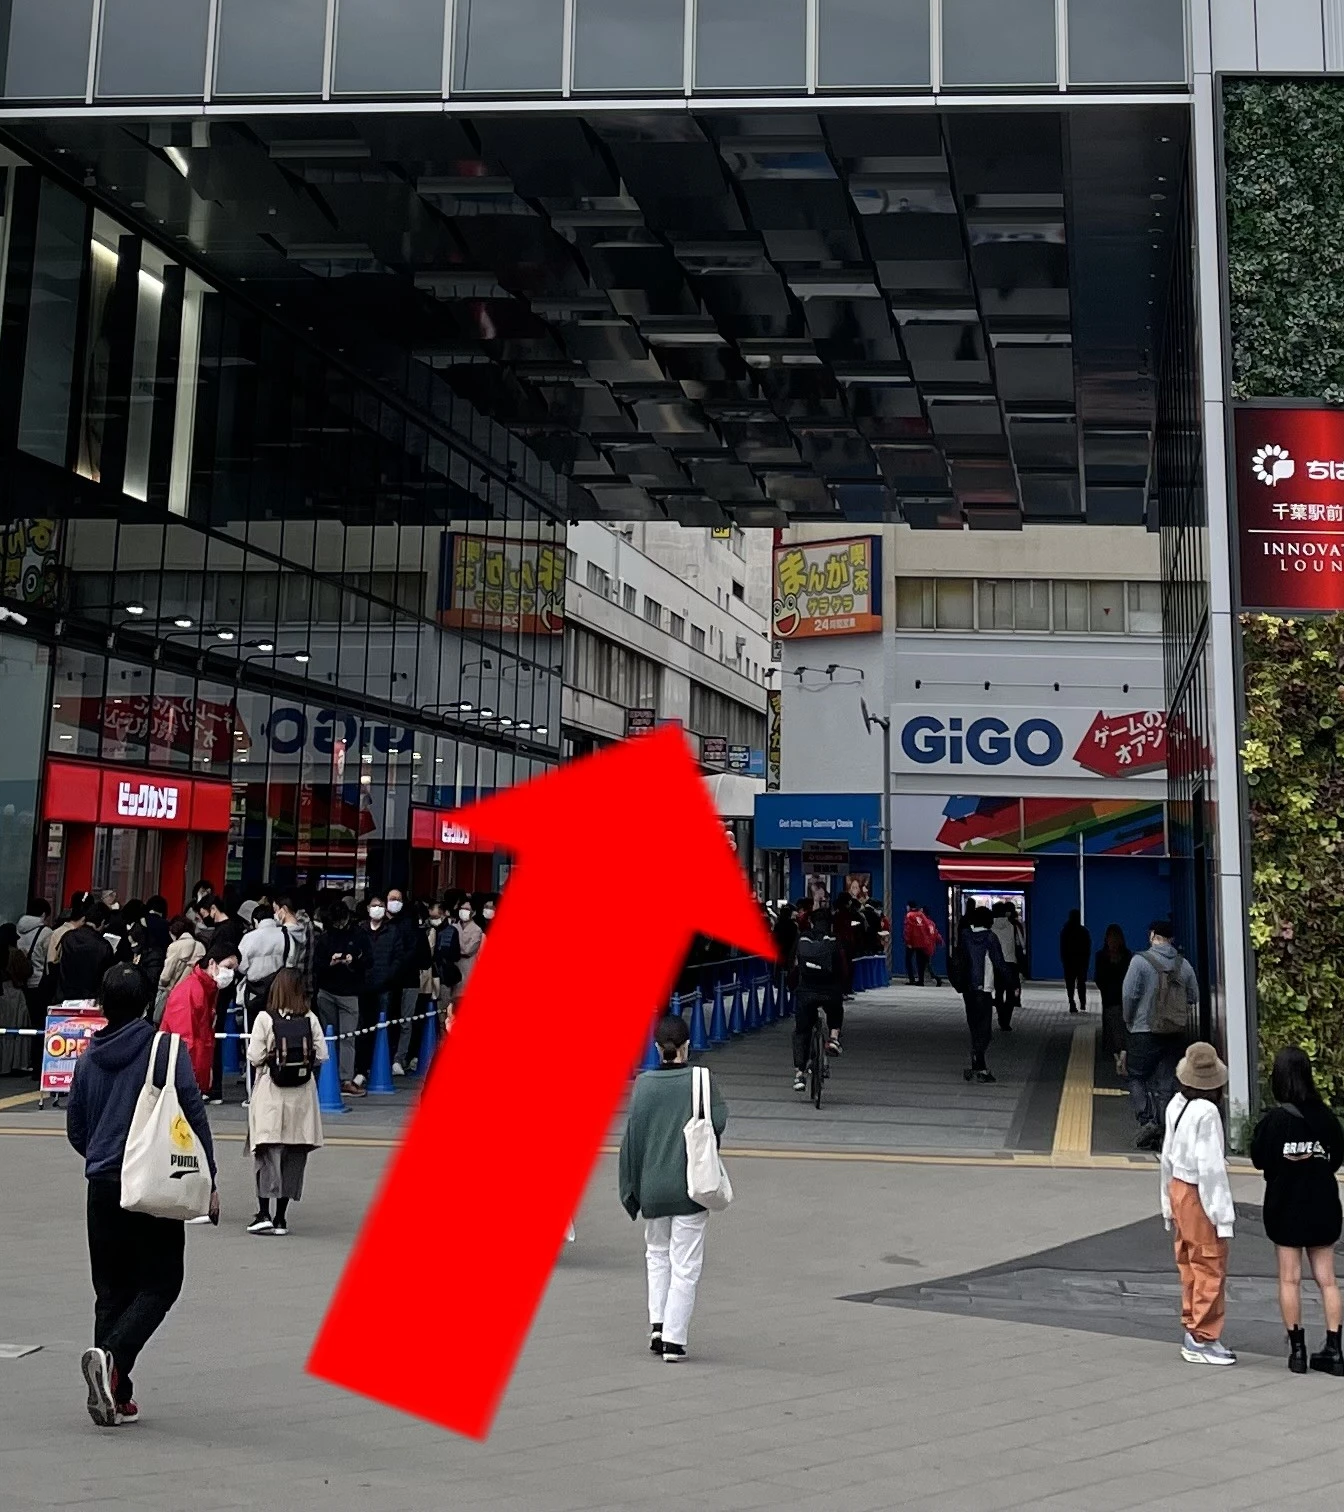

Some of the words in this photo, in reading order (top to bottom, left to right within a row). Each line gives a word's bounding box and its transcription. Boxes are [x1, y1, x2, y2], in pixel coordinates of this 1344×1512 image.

[779, 550, 848, 595] まんが
[901, 716, 1064, 766] GiGO
[171, 1154, 199, 1168] PUMA
